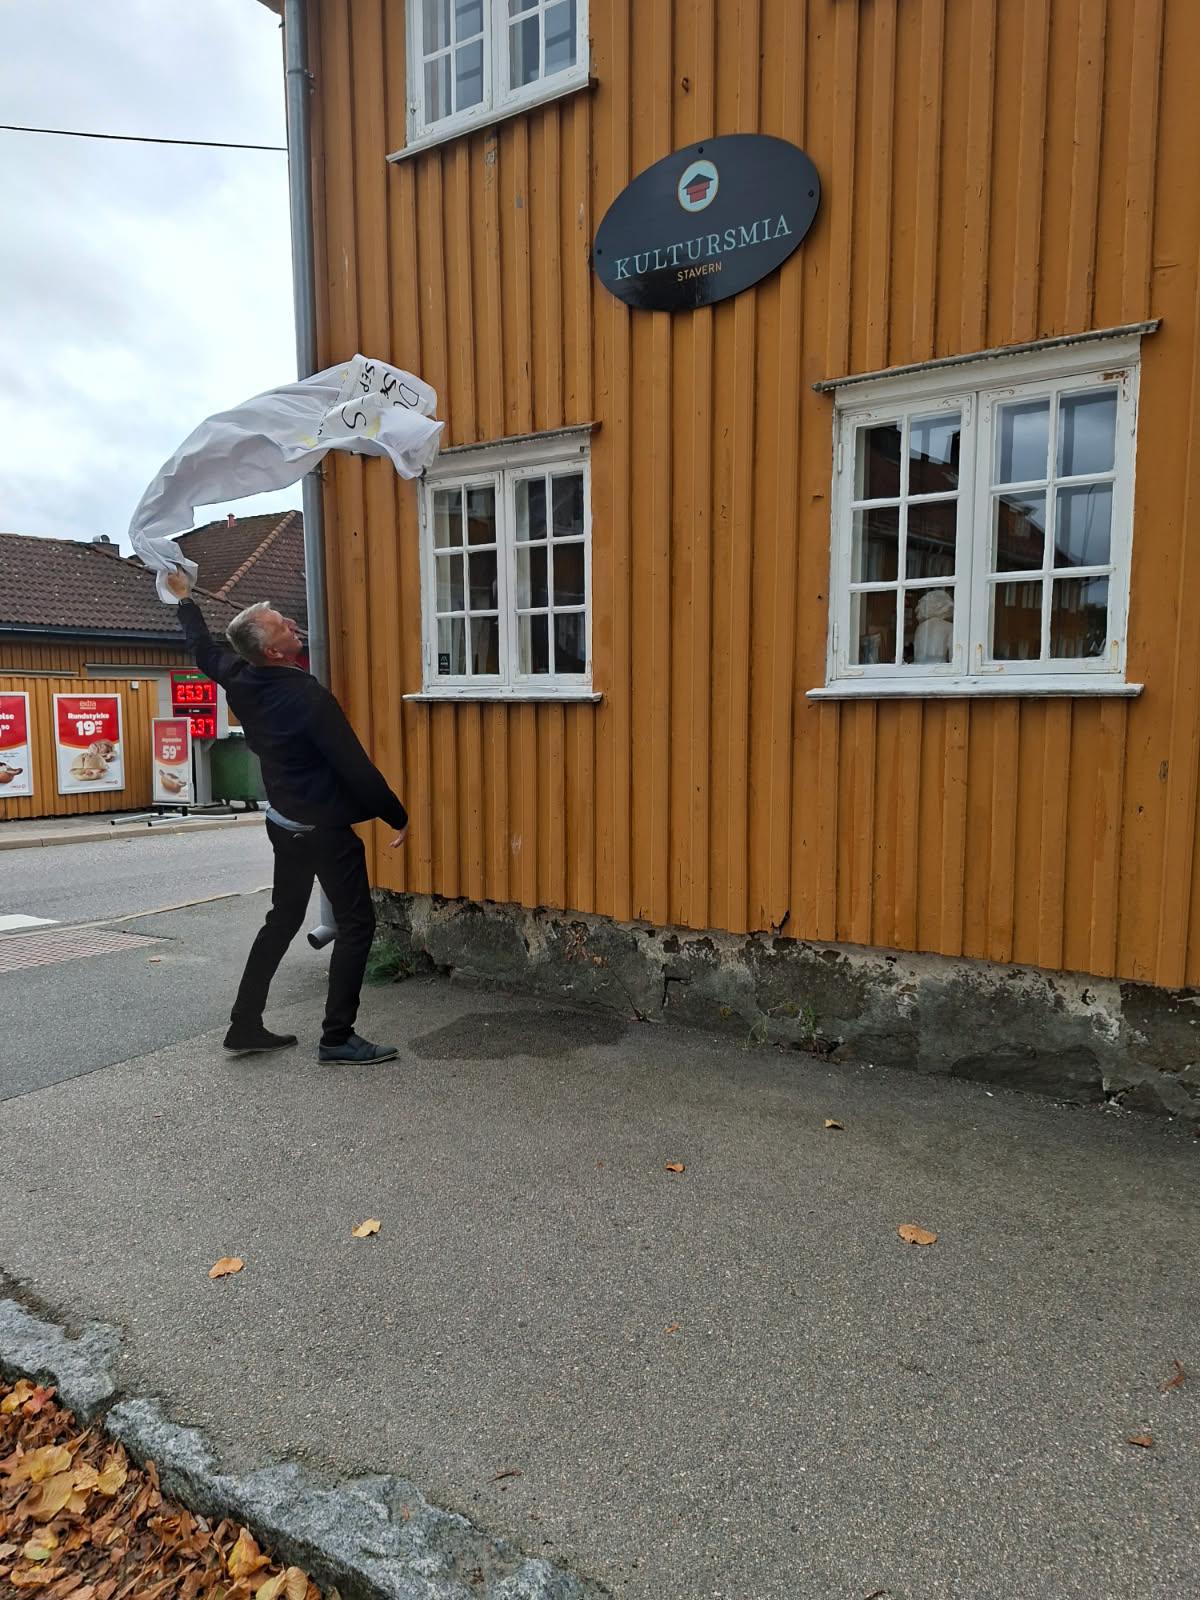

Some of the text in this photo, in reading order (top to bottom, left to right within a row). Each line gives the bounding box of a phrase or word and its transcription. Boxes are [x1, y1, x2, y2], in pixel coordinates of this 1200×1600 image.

[615, 214, 792, 281] KULTURSMIA
[677, 261, 722, 282] STAVERN
[67, 712, 110, 721] Rundstykke
[162, 745, 177, 760] 59
